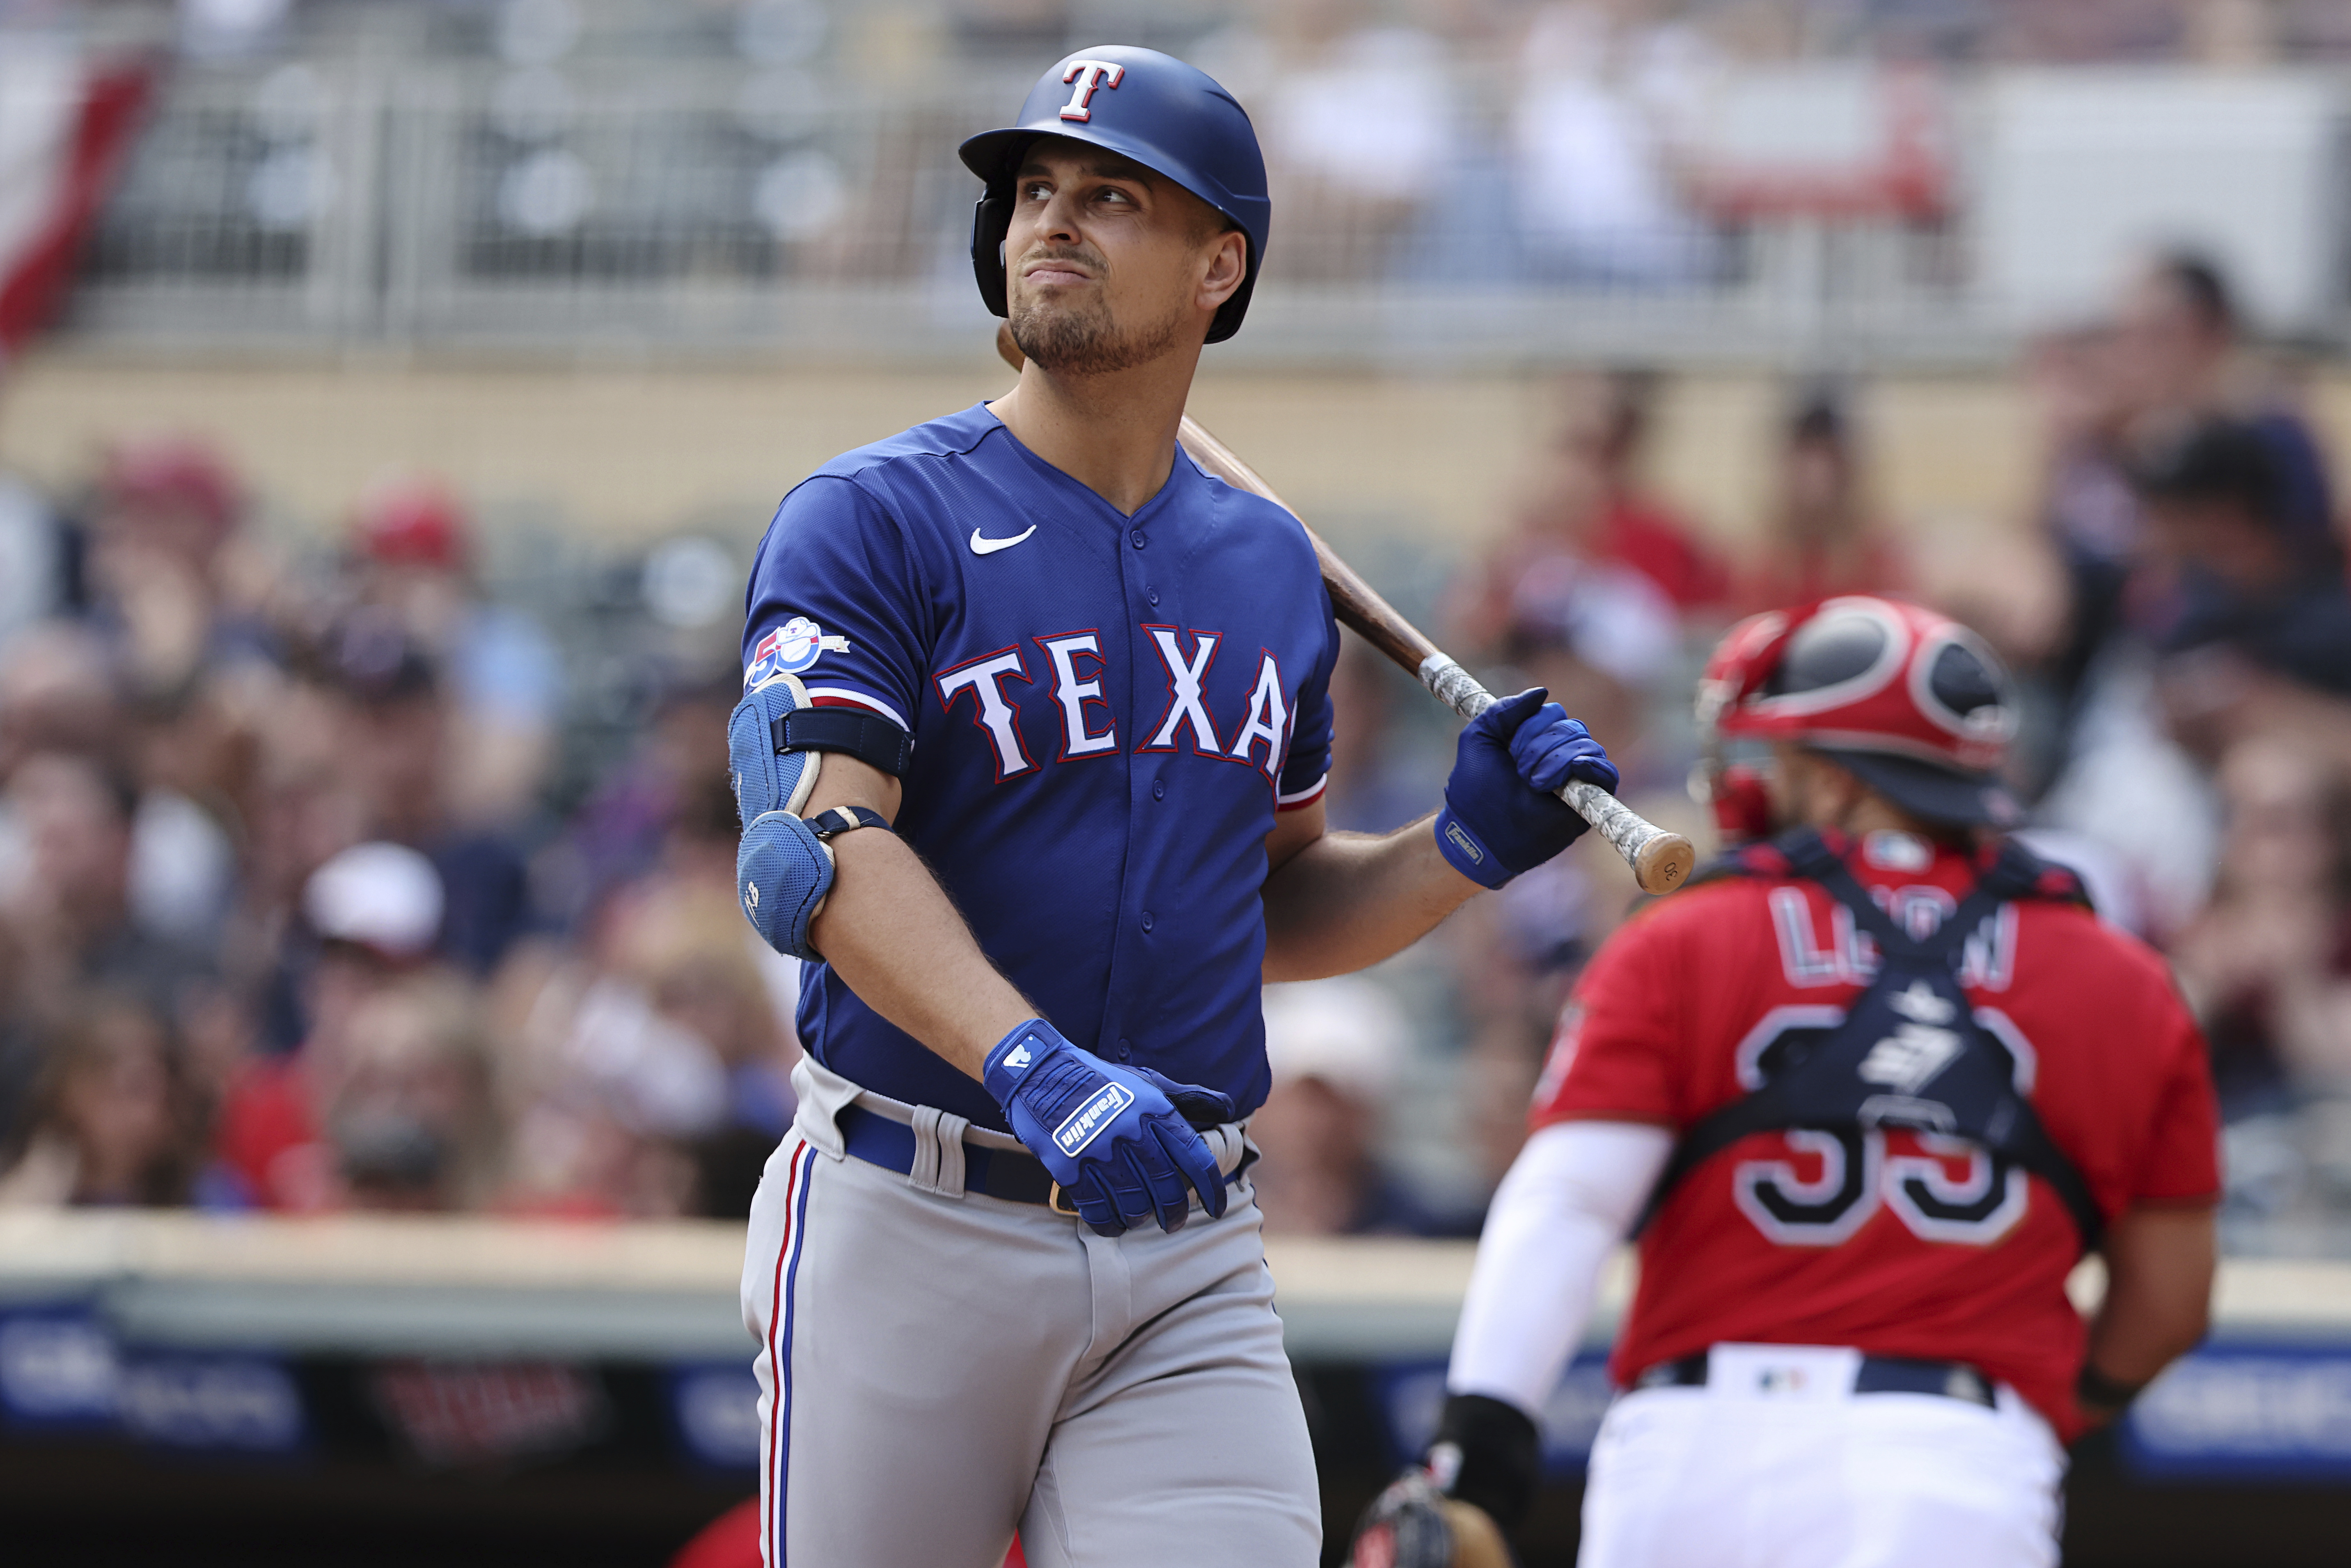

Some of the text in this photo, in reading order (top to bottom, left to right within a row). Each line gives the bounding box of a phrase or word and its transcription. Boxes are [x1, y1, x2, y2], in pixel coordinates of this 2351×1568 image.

[1059, 60, 1125, 122] T
[932, 624, 1298, 812] TEXA
[1664, 862, 1677, 881] 30
